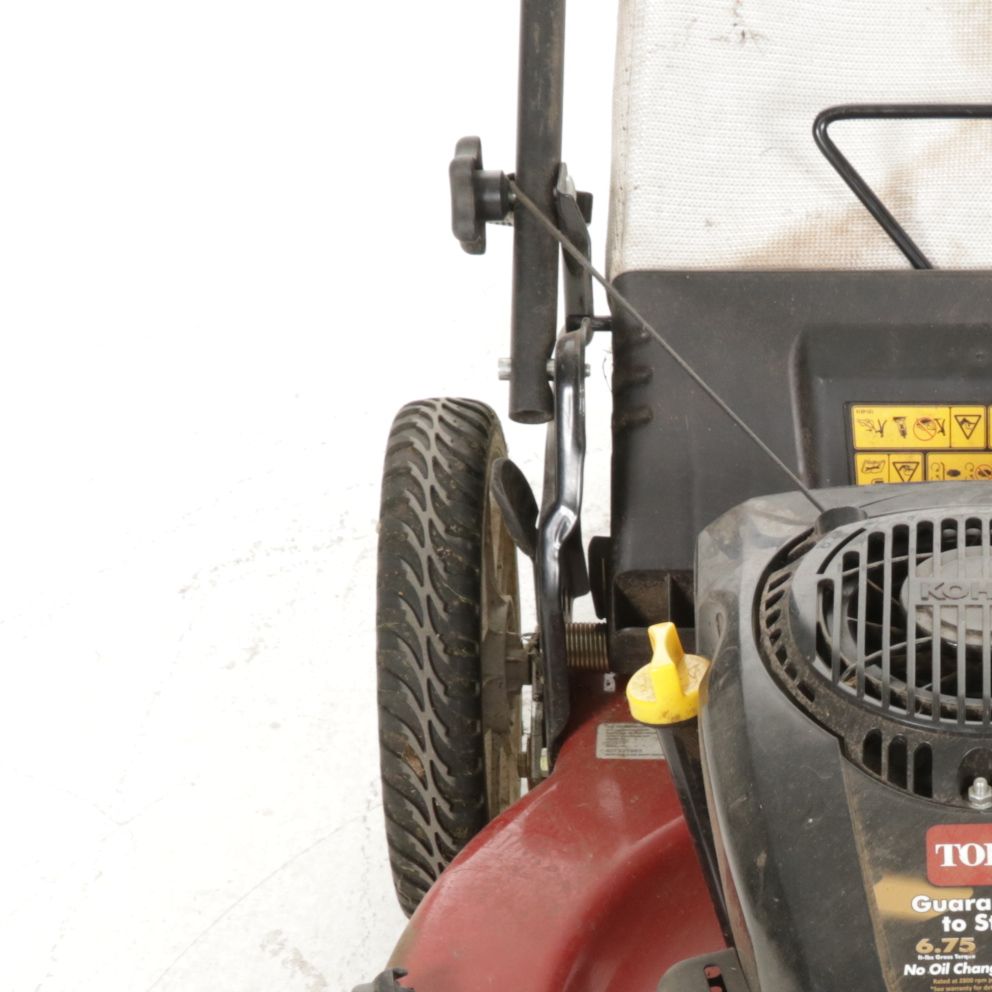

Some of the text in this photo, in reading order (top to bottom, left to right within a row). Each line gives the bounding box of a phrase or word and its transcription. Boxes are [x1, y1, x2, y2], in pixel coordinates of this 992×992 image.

[942, 917, 967, 932] to
[915, 937, 976, 954] 6.75
[904, 964, 925, 976] No
[929, 962, 950, 976] Oil
